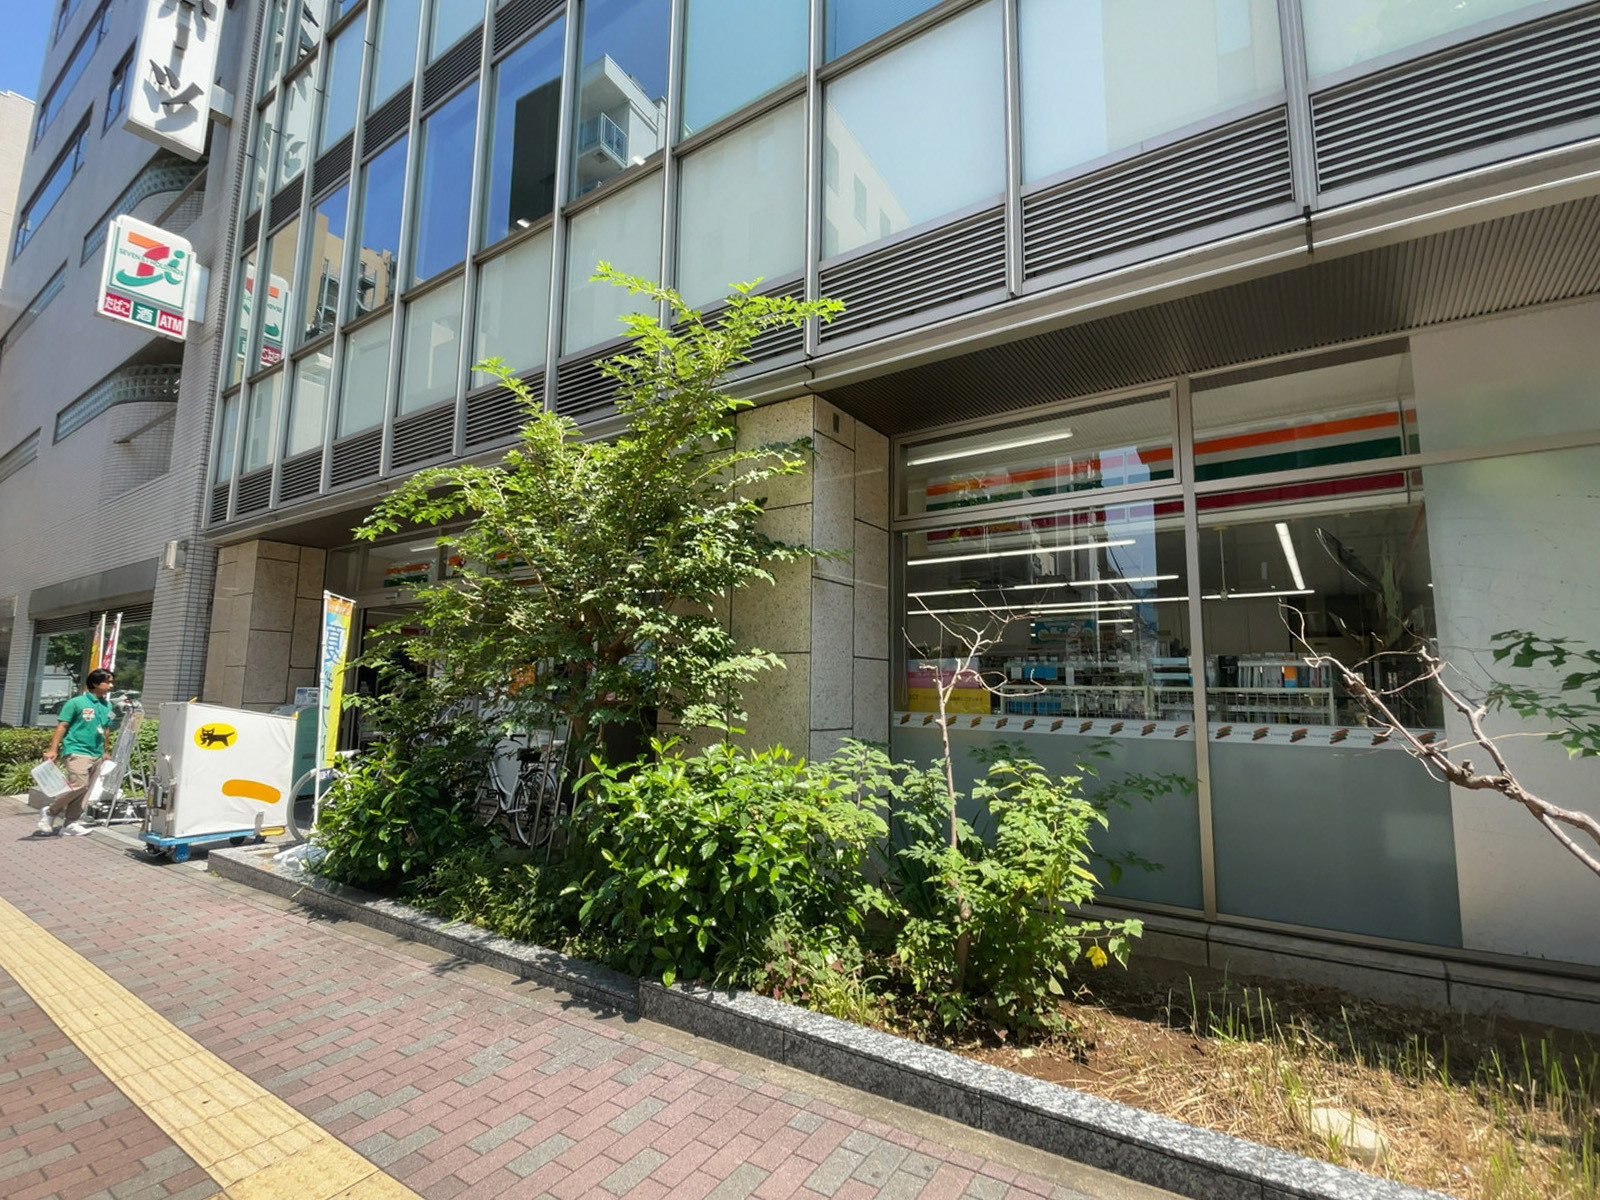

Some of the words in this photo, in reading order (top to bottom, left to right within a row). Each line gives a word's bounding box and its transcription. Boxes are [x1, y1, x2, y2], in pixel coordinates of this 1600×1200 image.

[105, 296, 130, 315] たばこ
[136, 305, 154, 322] 酒
[159, 315, 183, 332] ATM
